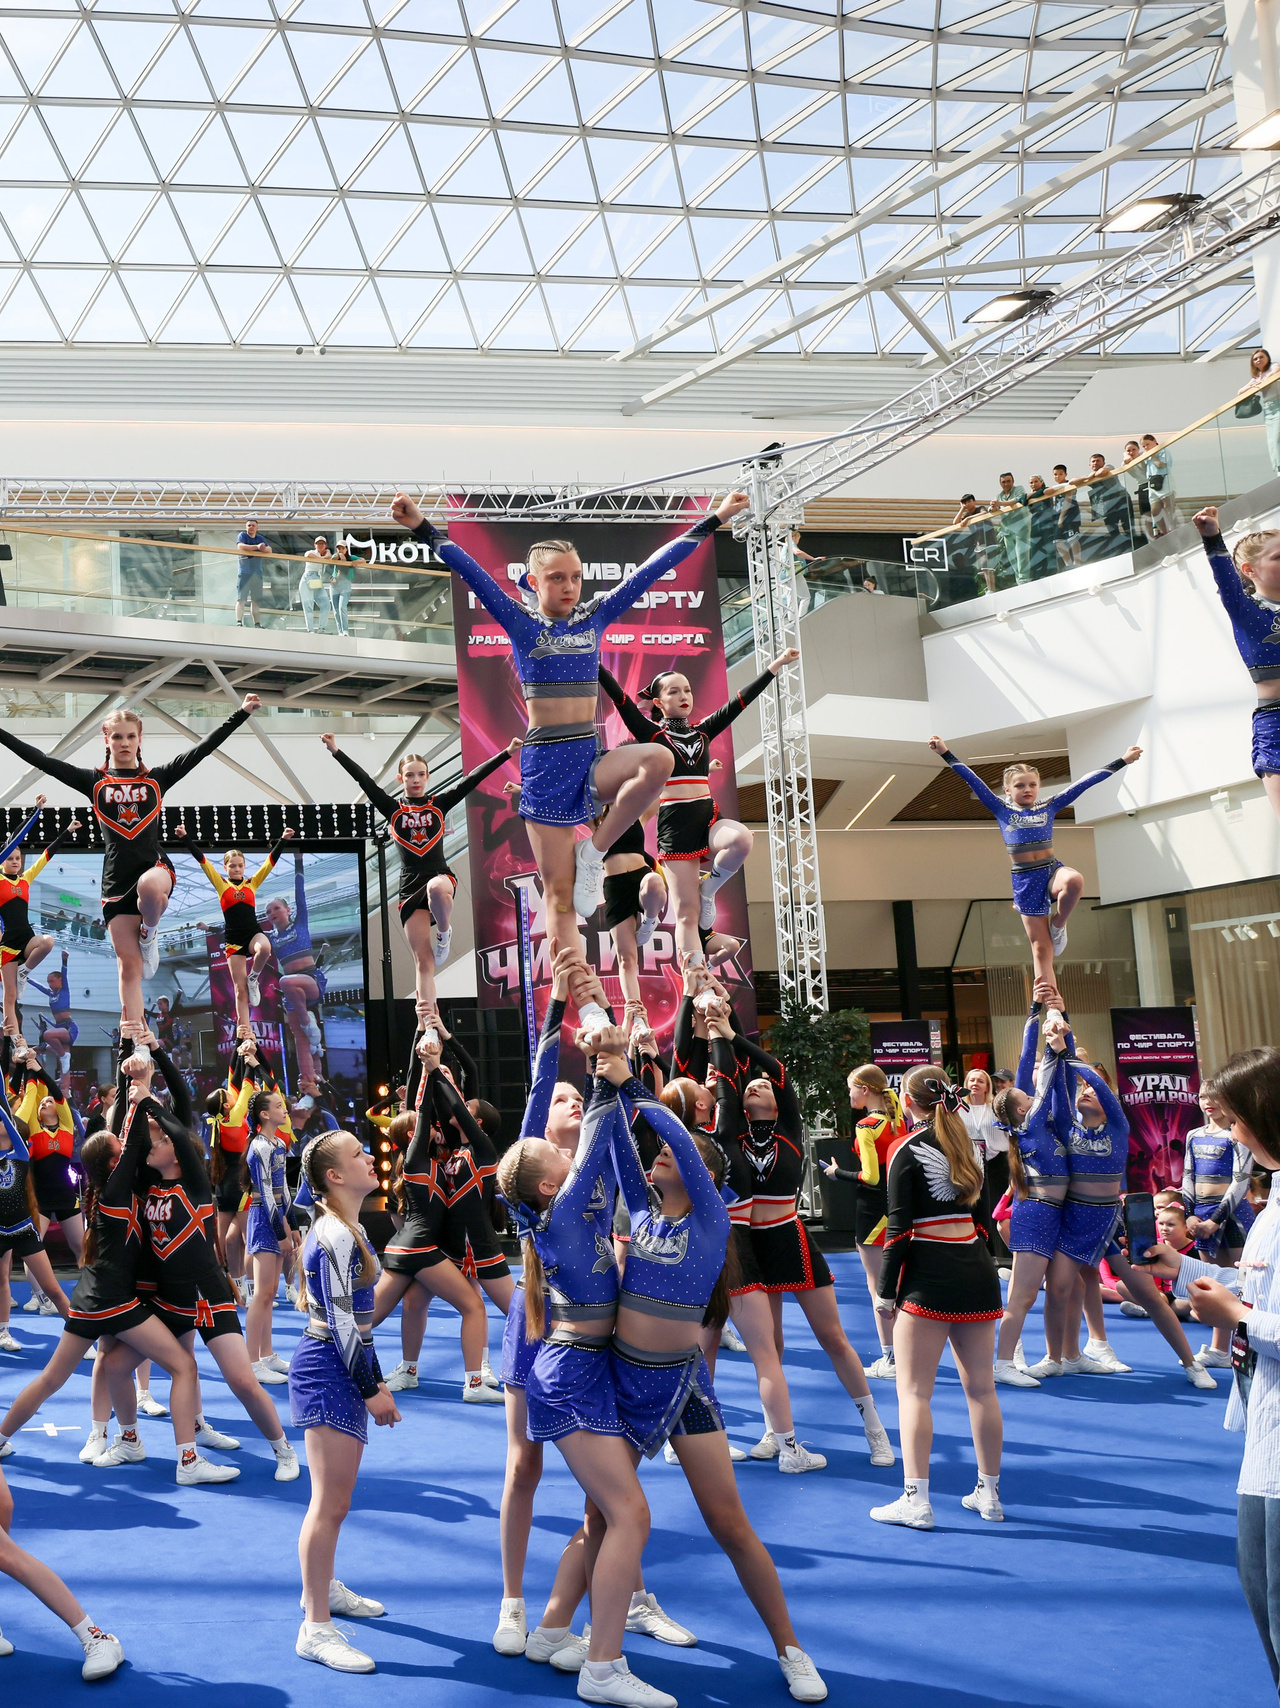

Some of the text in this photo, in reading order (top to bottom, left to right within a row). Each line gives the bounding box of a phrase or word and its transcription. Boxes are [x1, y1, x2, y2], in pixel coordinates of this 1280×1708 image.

[910, 548, 939, 562] CR
[593, 591, 705, 610] ОРТУ
[606, 633, 635, 645] ЧИР
[642, 633, 705, 645] СПОРТА
[104, 783, 148, 804] FOXES
[401, 812, 433, 829] FOXES
[222, 1021, 275, 1040] УАЛ
[1129, 1033, 1186, 1041] ФЕСТИВАЛЬ
[1131, 1074, 1188, 1093] УРАЛ
[1124, 1090, 1199, 1106] ЧИР И РОК
